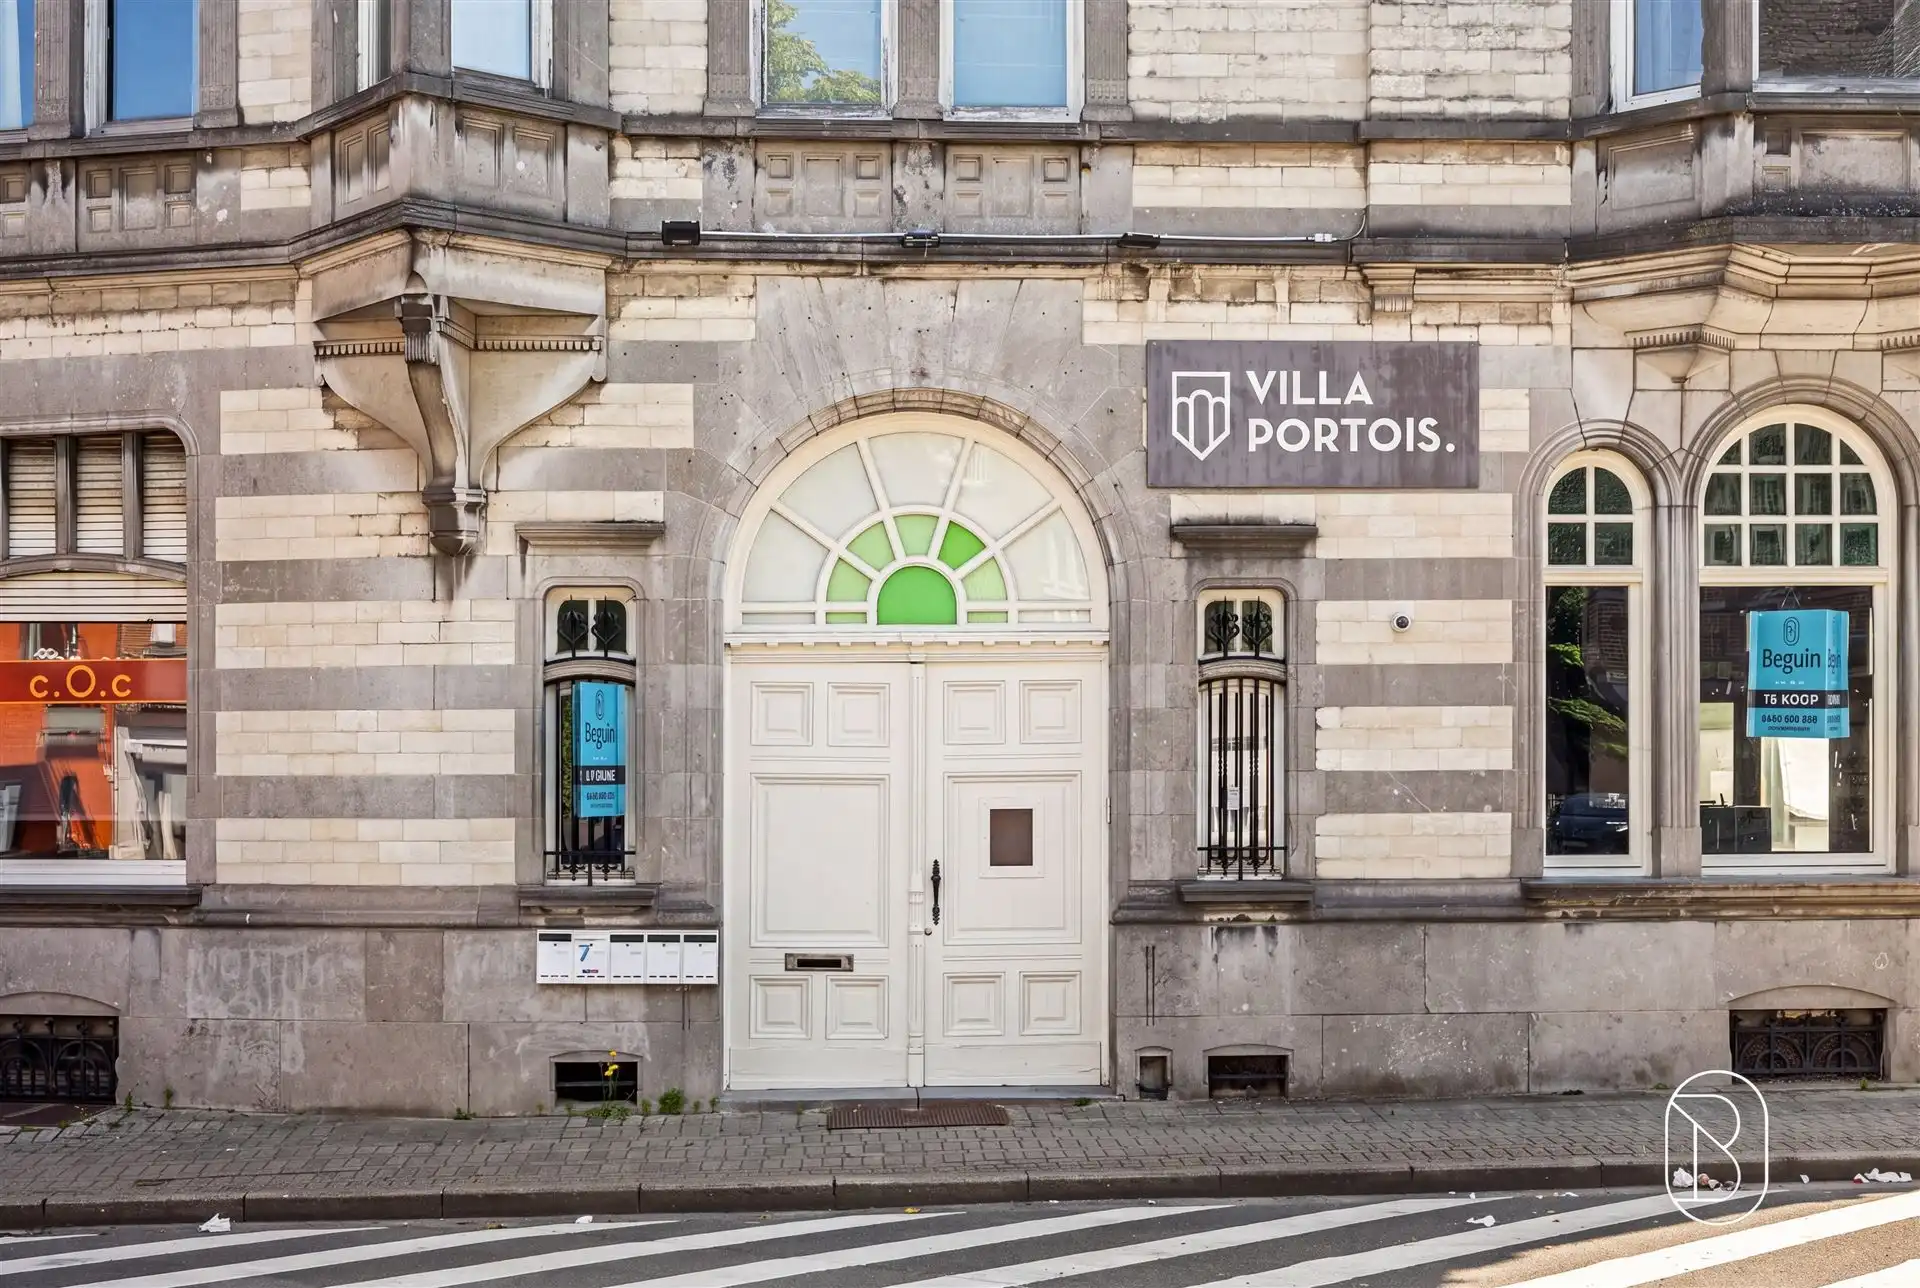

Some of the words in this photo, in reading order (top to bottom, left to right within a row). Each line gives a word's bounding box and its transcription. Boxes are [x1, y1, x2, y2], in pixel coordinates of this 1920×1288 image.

[1246, 370, 1374, 405] VILLA
[1248, 417, 1456, 453] PORTOIS.
[1762, 648, 1821, 674] Beguin
[1781, 693, 1819, 705] KOOP
[585, 721, 616, 750] Beguin
[578, 944, 590, 962] 7
